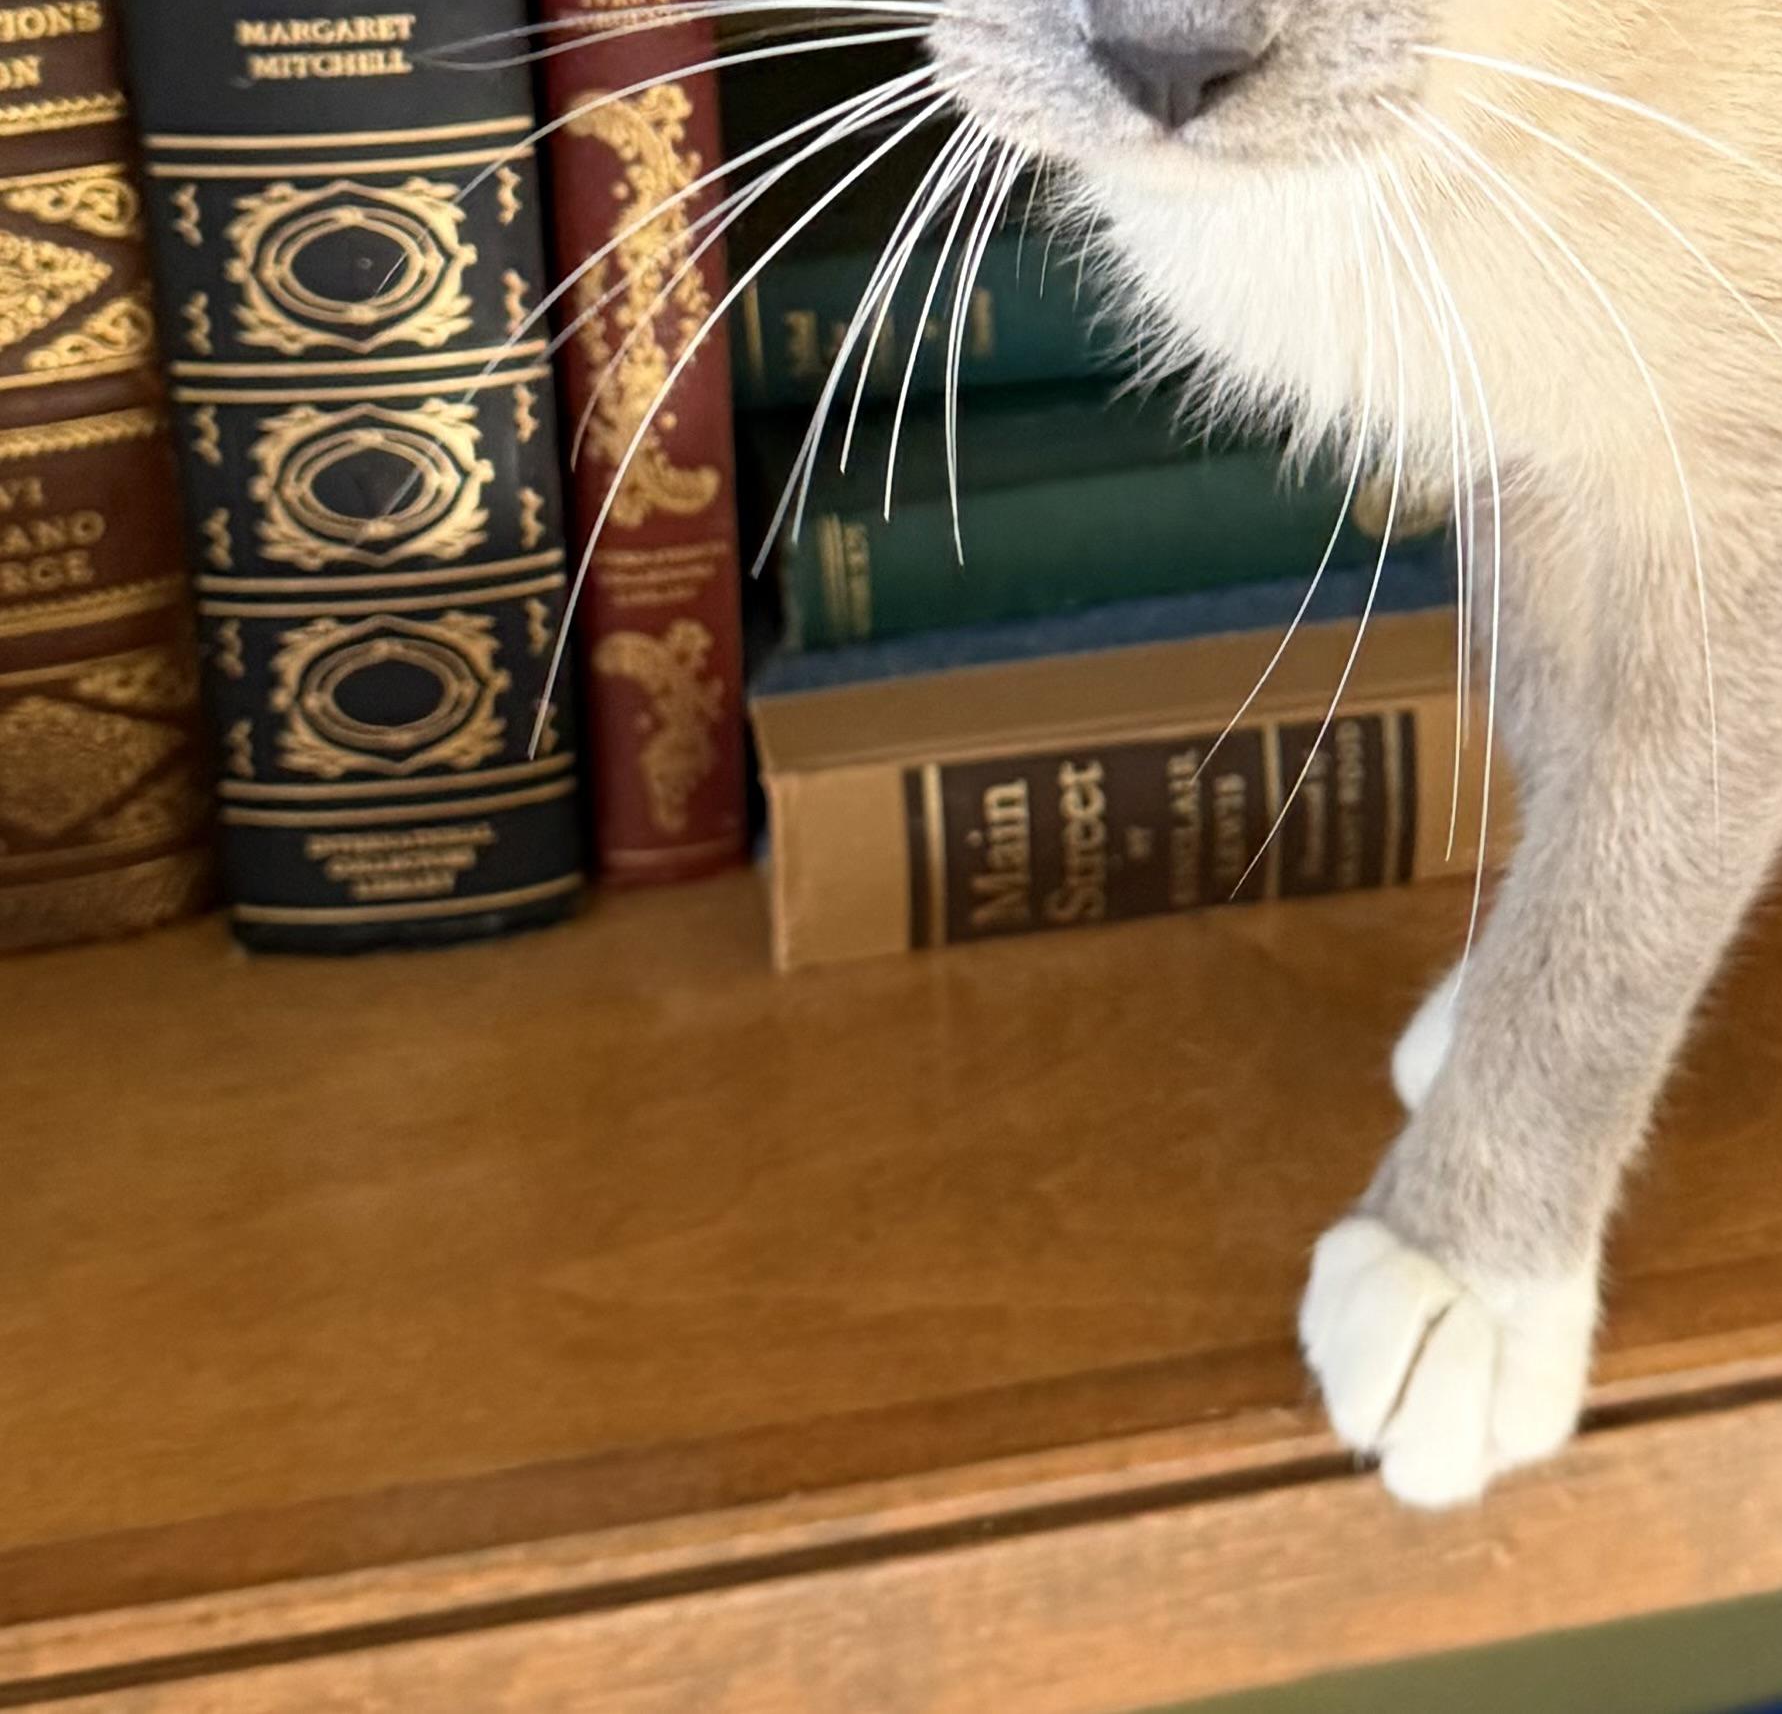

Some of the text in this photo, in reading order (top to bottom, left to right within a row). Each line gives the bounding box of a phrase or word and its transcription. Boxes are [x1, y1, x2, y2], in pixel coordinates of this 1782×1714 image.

[236, 14, 416, 46] MARGARET
[247, 48, 413, 79] MITCHELL
[967, 778, 1030, 929] Main
[1047, 761, 1106, 924] Street
